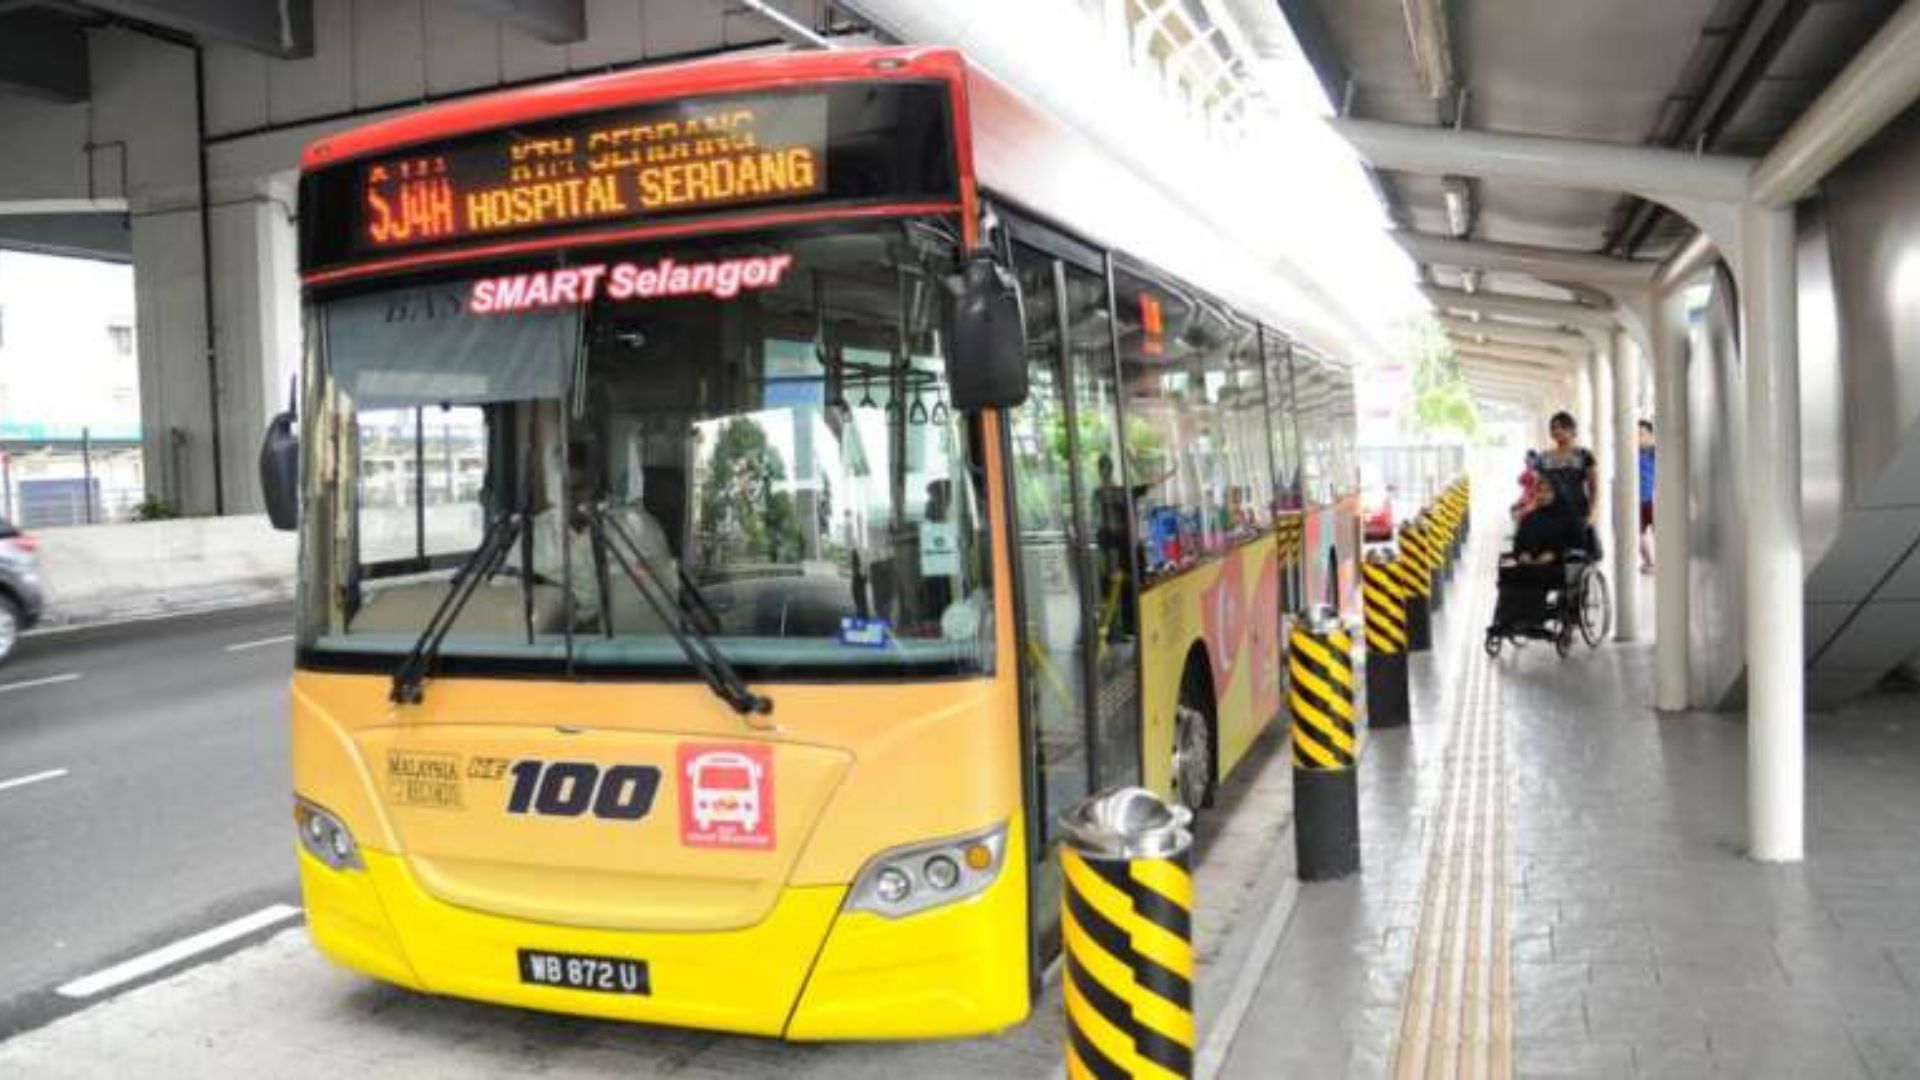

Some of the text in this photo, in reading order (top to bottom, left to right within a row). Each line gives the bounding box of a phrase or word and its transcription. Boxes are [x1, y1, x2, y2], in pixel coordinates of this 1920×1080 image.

[467, 174, 626, 231] HOSPITAL
[637, 147, 815, 209] SERDANG
[470, 253, 792, 314] SMART Selangor
[506, 759, 662, 820] 100
[529, 953, 637, 991] WB 872 U
